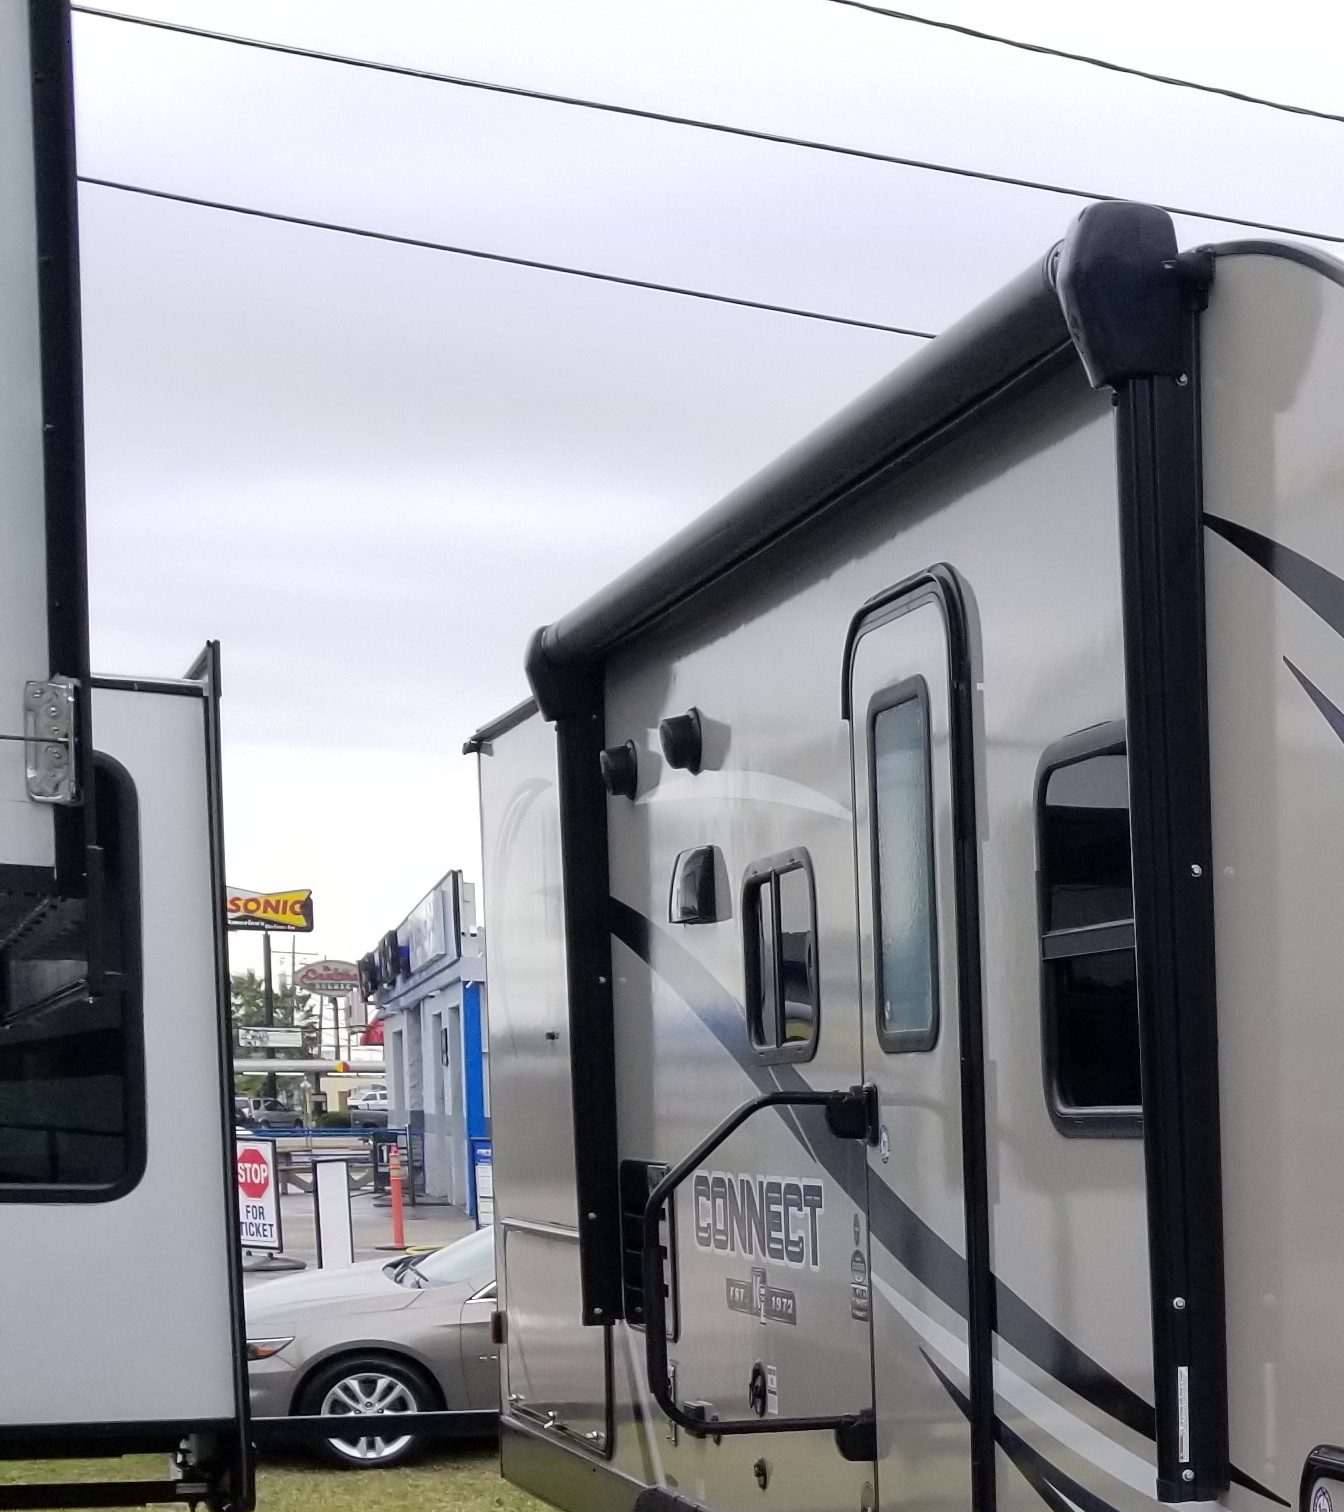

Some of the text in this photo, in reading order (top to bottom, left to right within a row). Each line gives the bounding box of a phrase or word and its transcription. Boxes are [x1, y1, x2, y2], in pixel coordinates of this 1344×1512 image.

[227, 896, 304, 916] SONIC
[238, 1162, 268, 1184] STOP
[245, 1204, 265, 1221] FOR
[694, 1171, 824, 1271] CONNECT
[240, 1221, 274, 1238] TICKET
[772, 1296, 793, 1314] 1972
